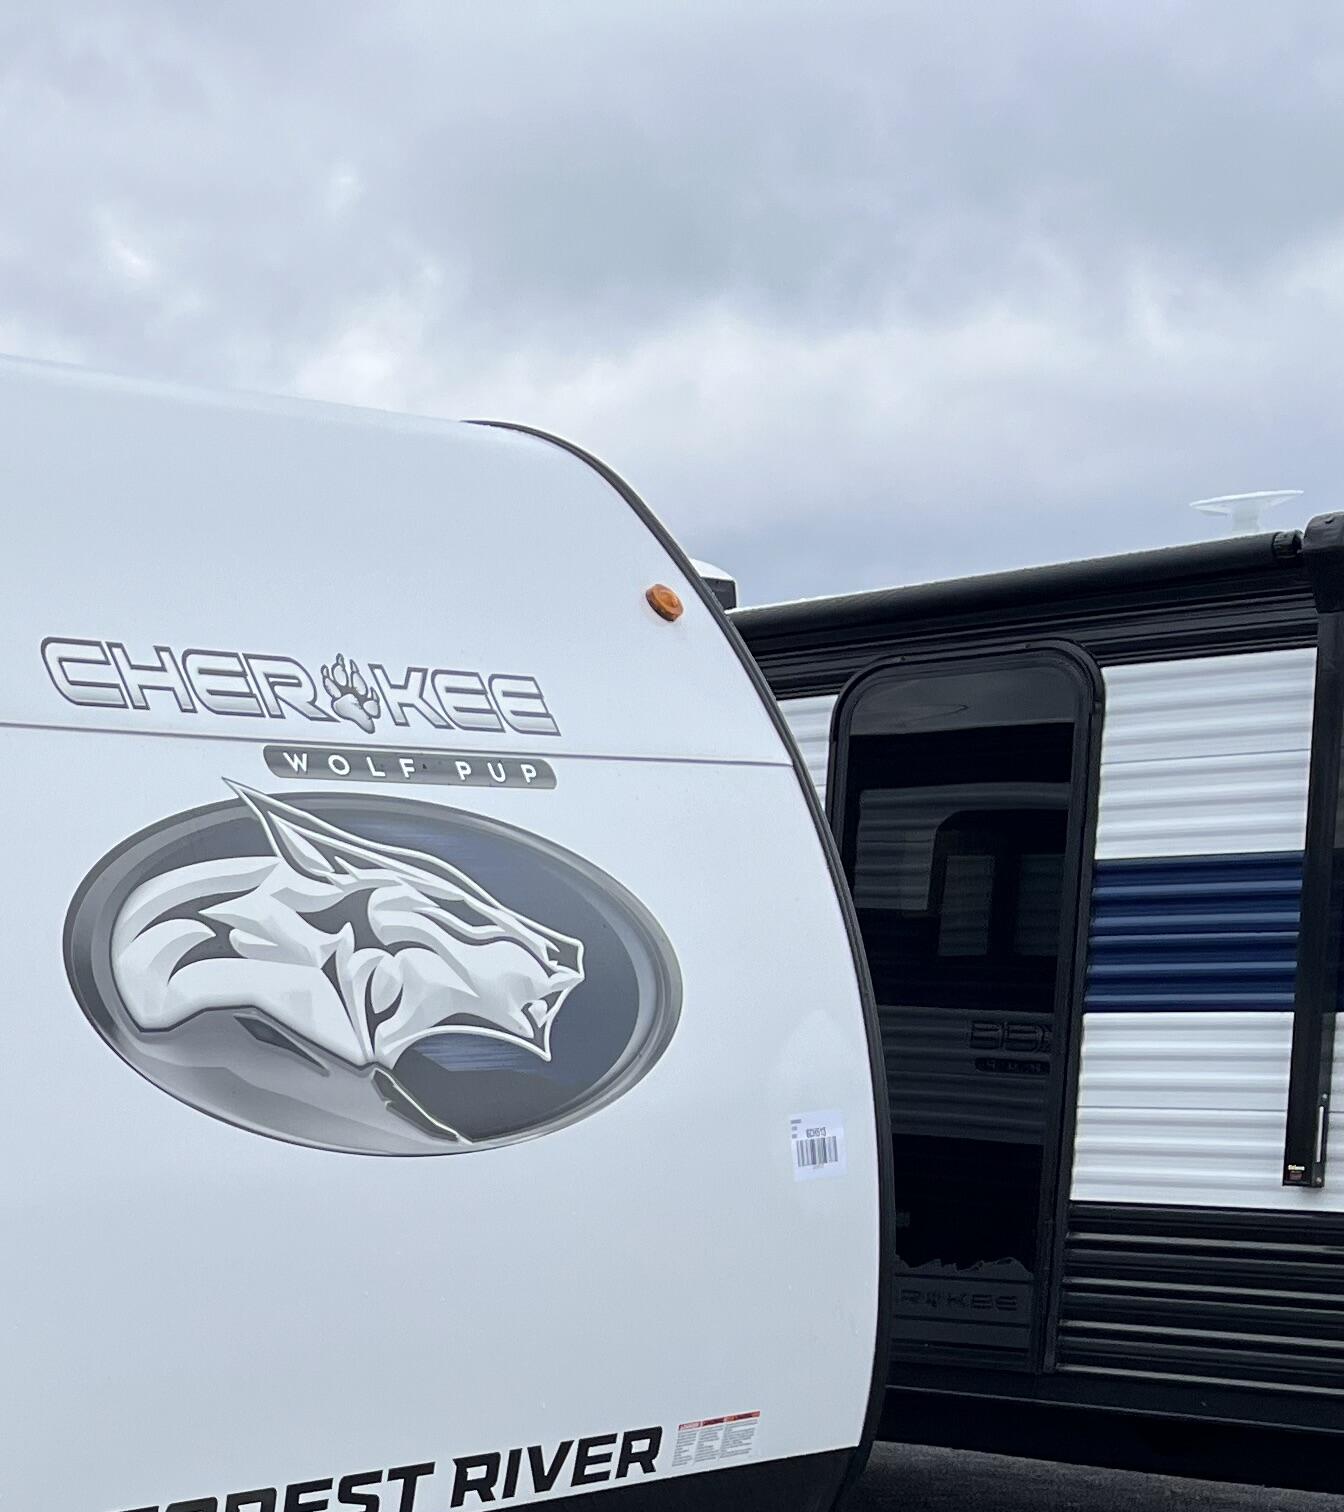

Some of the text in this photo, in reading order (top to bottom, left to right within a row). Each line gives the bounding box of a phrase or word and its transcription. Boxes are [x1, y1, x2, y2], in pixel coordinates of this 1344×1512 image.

[283, 751, 539, 785] WOLF PUP
[449, 1425, 664, 1508] RIVER
